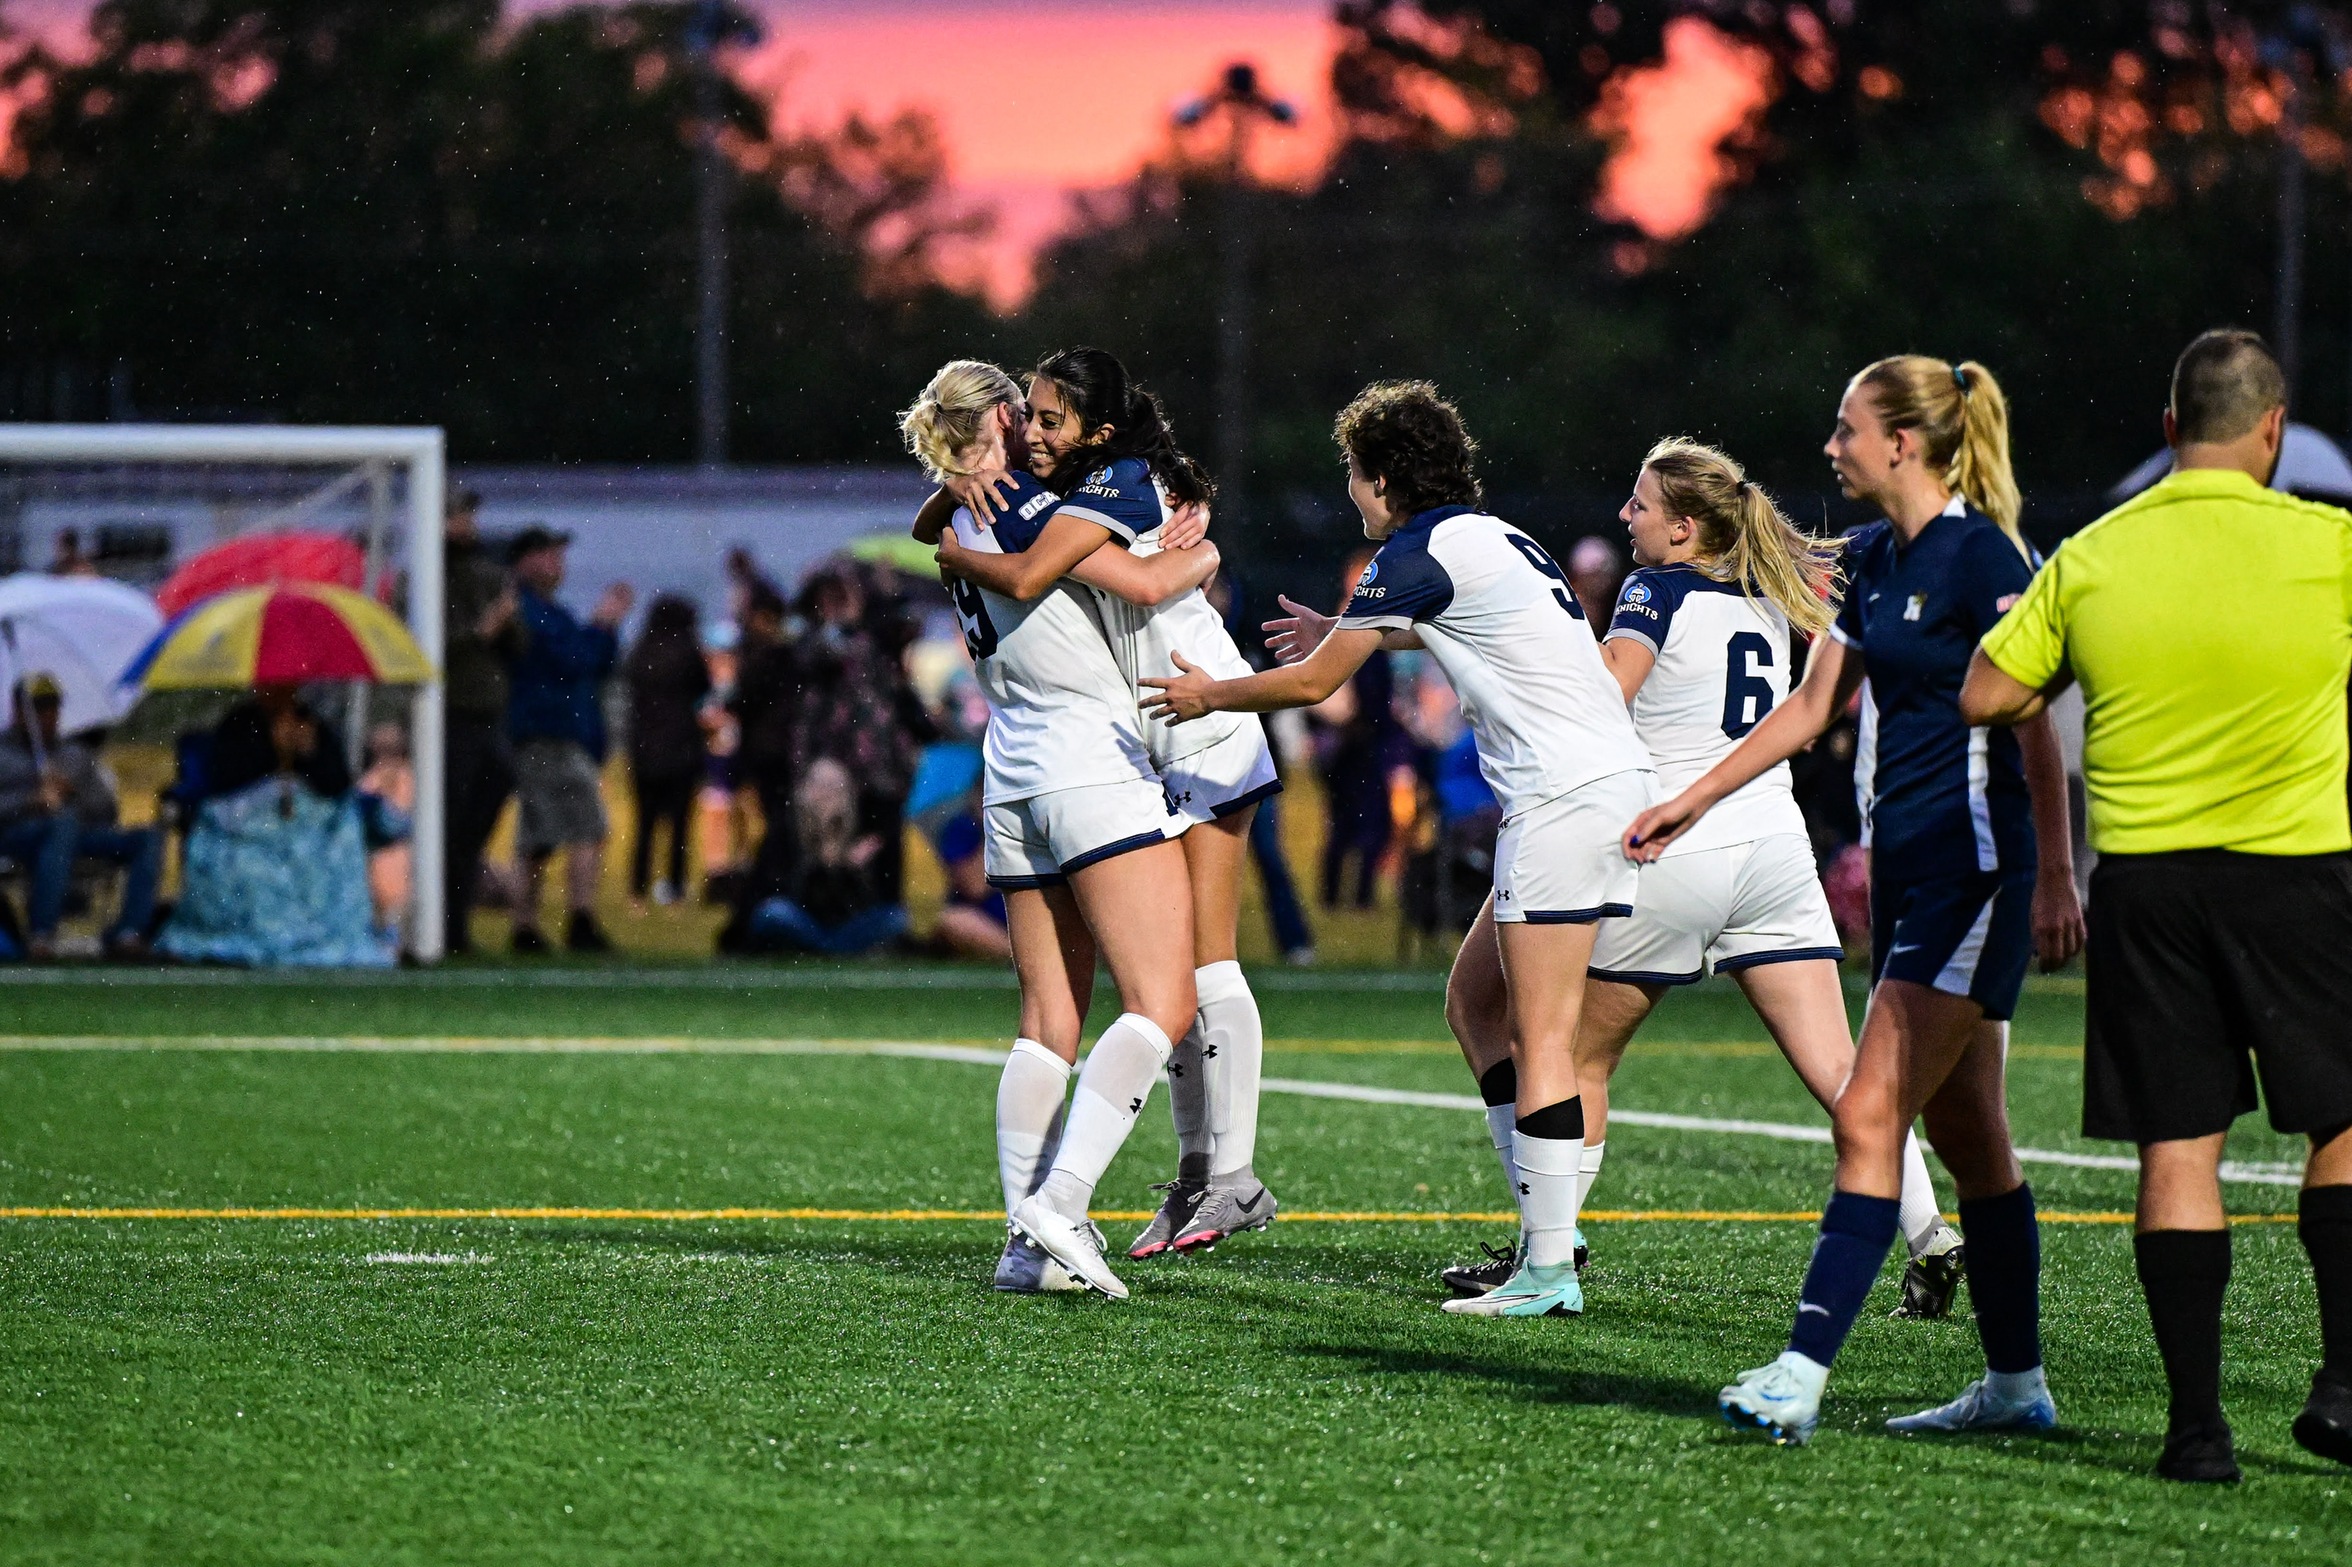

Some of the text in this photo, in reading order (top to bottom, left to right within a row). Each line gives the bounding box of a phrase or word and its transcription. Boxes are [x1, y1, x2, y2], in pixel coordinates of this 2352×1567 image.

[1076, 484, 1120, 498] GHTS
[1504, 533, 1585, 620] 9
[1615, 602, 1658, 620] KNIGHTS
[1720, 631, 1774, 741] 6
